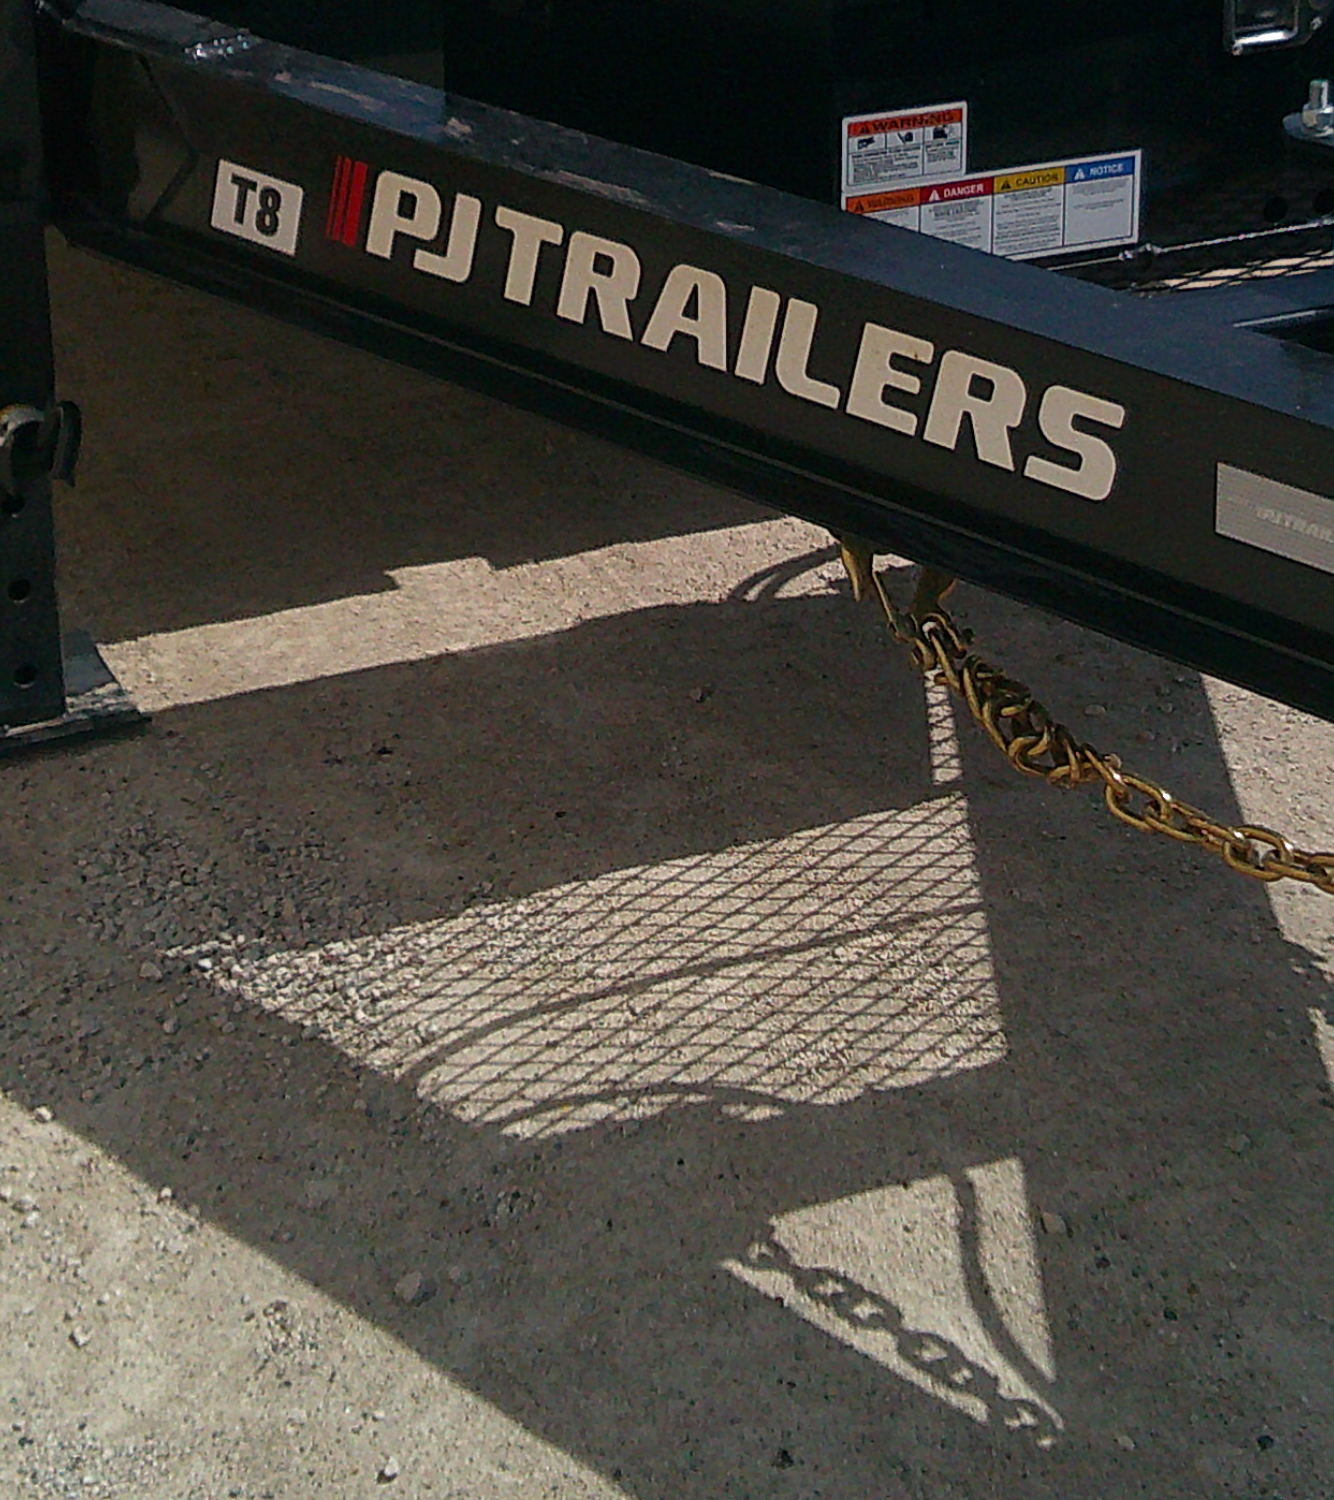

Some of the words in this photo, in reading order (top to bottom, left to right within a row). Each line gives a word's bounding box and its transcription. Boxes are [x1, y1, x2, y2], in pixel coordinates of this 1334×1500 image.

[872, 111, 954, 131] WARNING
[1089, 162, 1124, 176] NOTICE
[1015, 173, 1059, 187] CAUTION
[943, 183, 984, 198] DANGER
[230, 171, 282, 238] T8
[867, 194, 914, 208] WARNING
[366, 169, 482, 284] PJ
[494, 204, 1127, 502] TRAILERS
